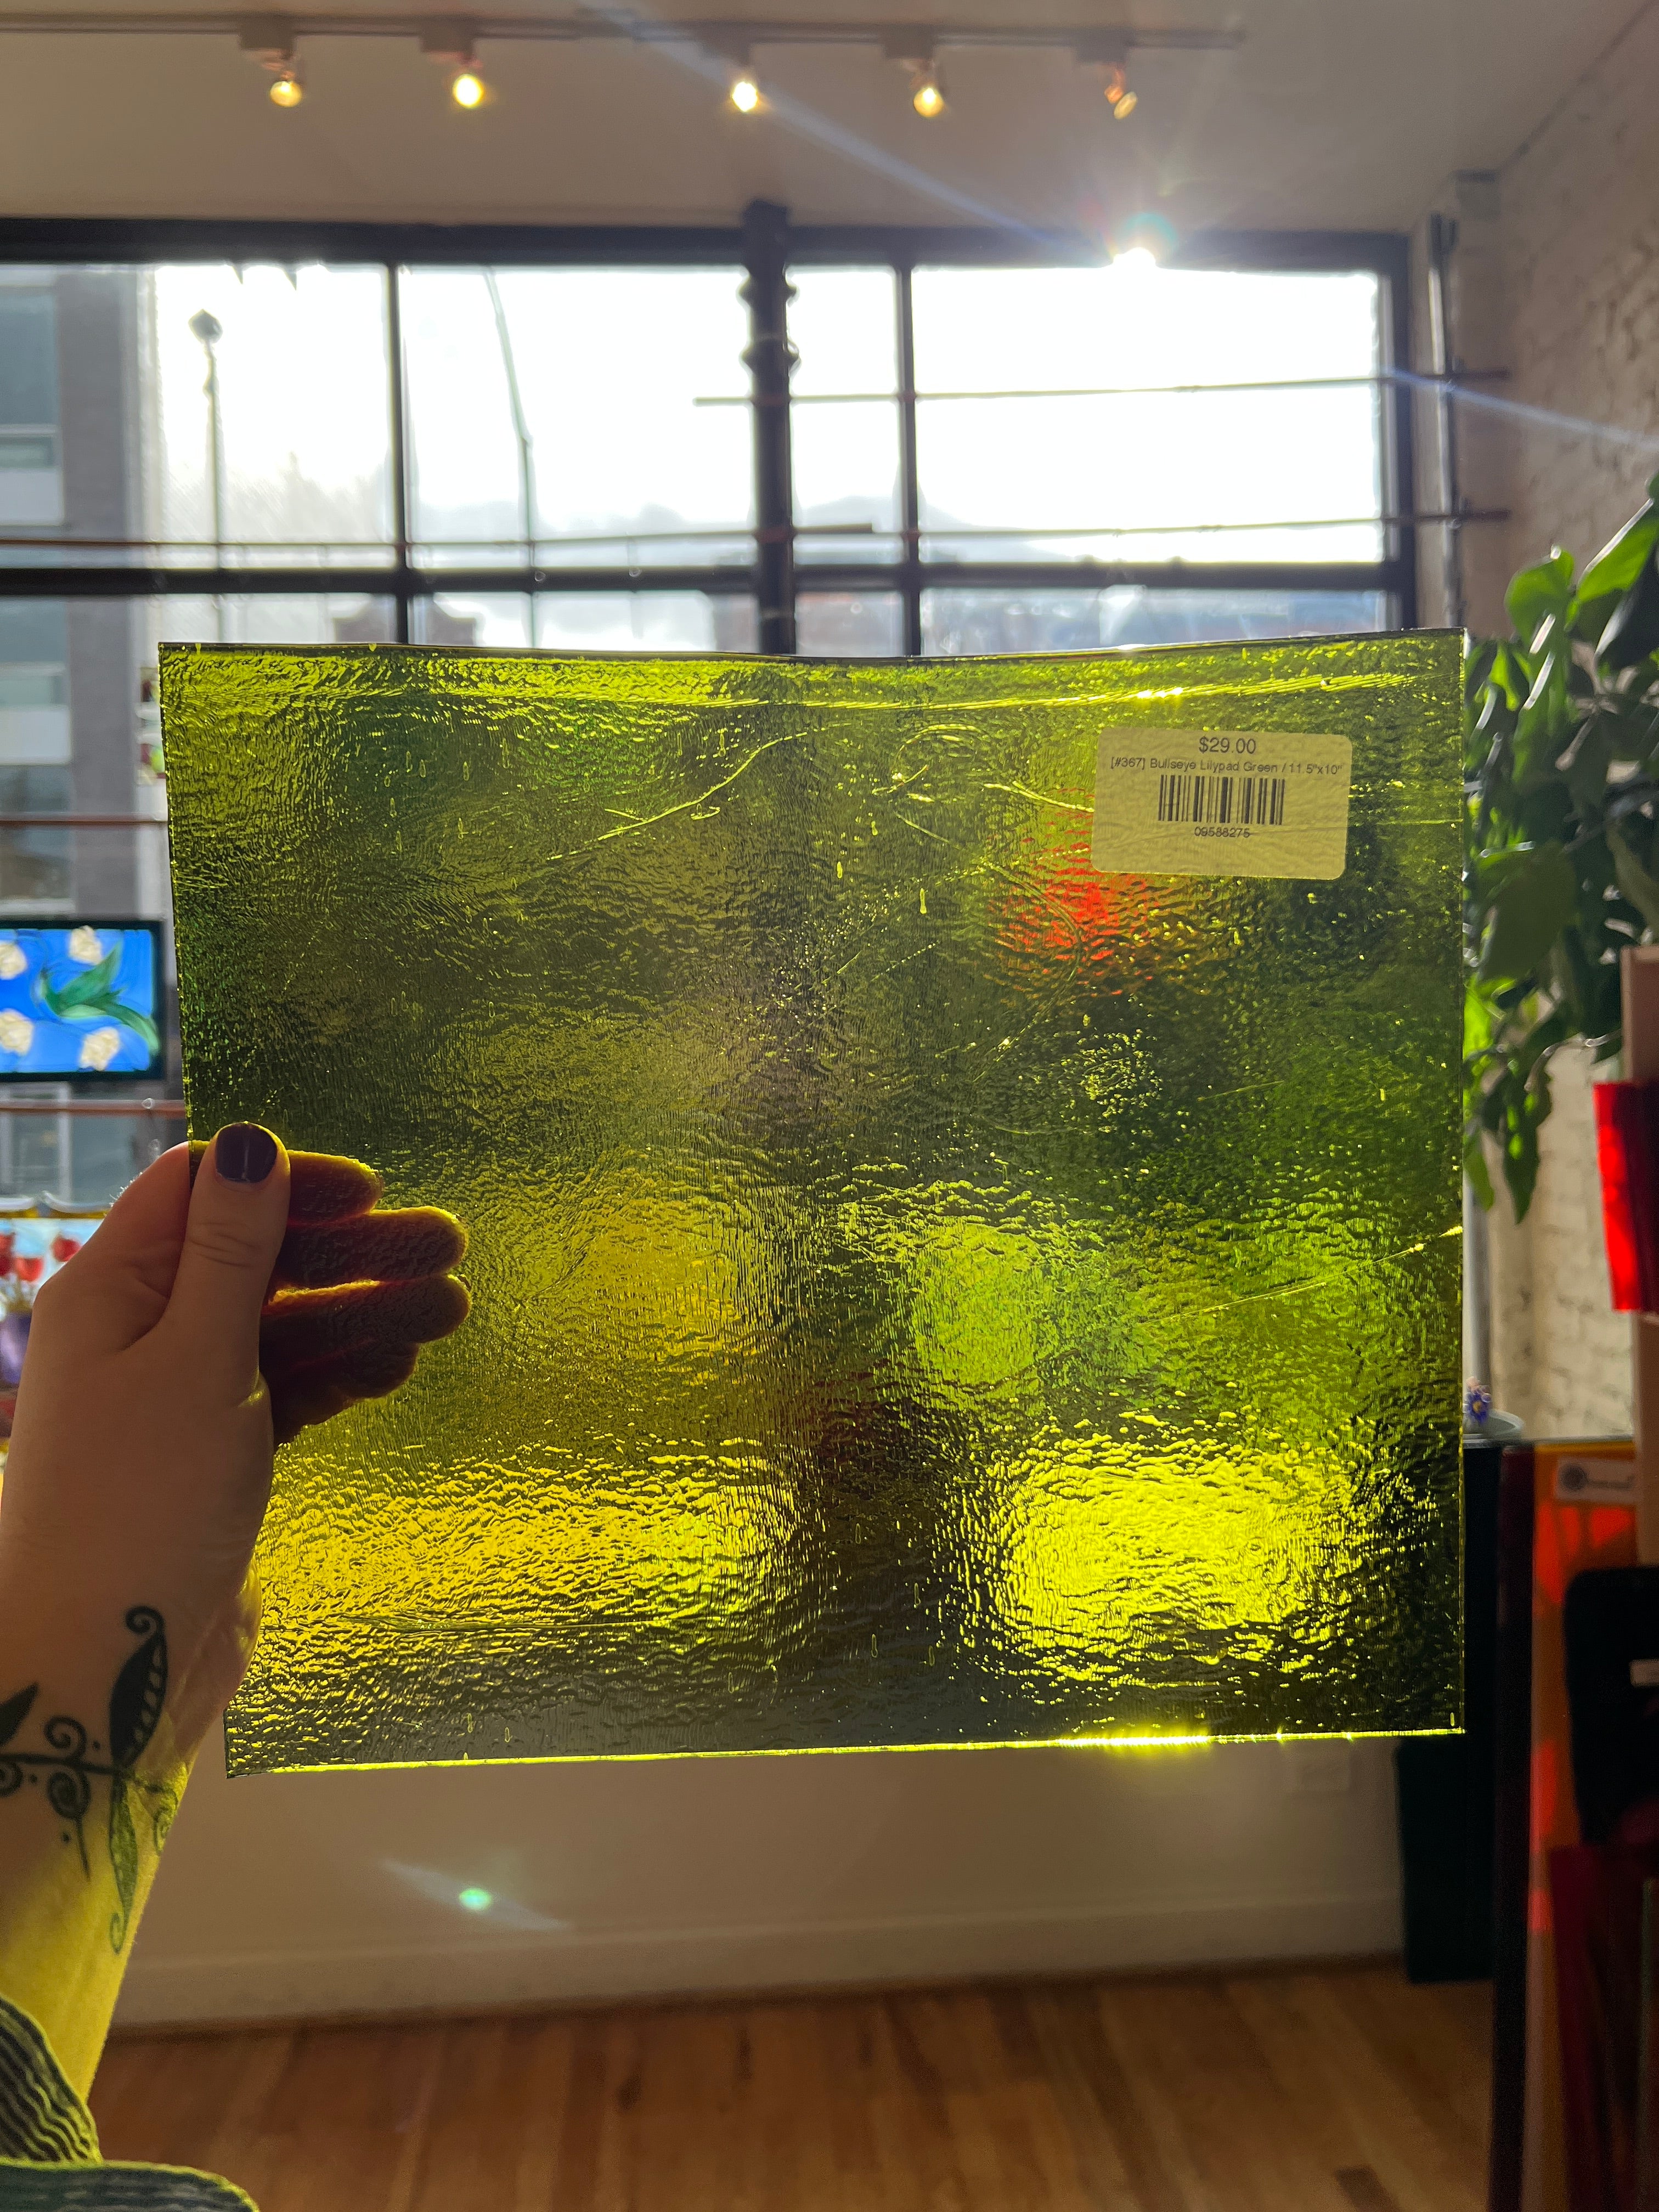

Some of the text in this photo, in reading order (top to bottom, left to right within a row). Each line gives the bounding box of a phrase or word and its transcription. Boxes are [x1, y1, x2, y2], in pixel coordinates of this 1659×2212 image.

[1199, 736, 1256, 754] $29.00
[1111, 756, 1146, 770] [#367]
[1150, 758, 1197, 772] Bullseye
[1200, 759, 1239, 773] Lilypad
[1243, 761, 1278, 773] Green
[1281, 763, 1287, 773] /
[1194, 826, 1250, 838] 09588275
